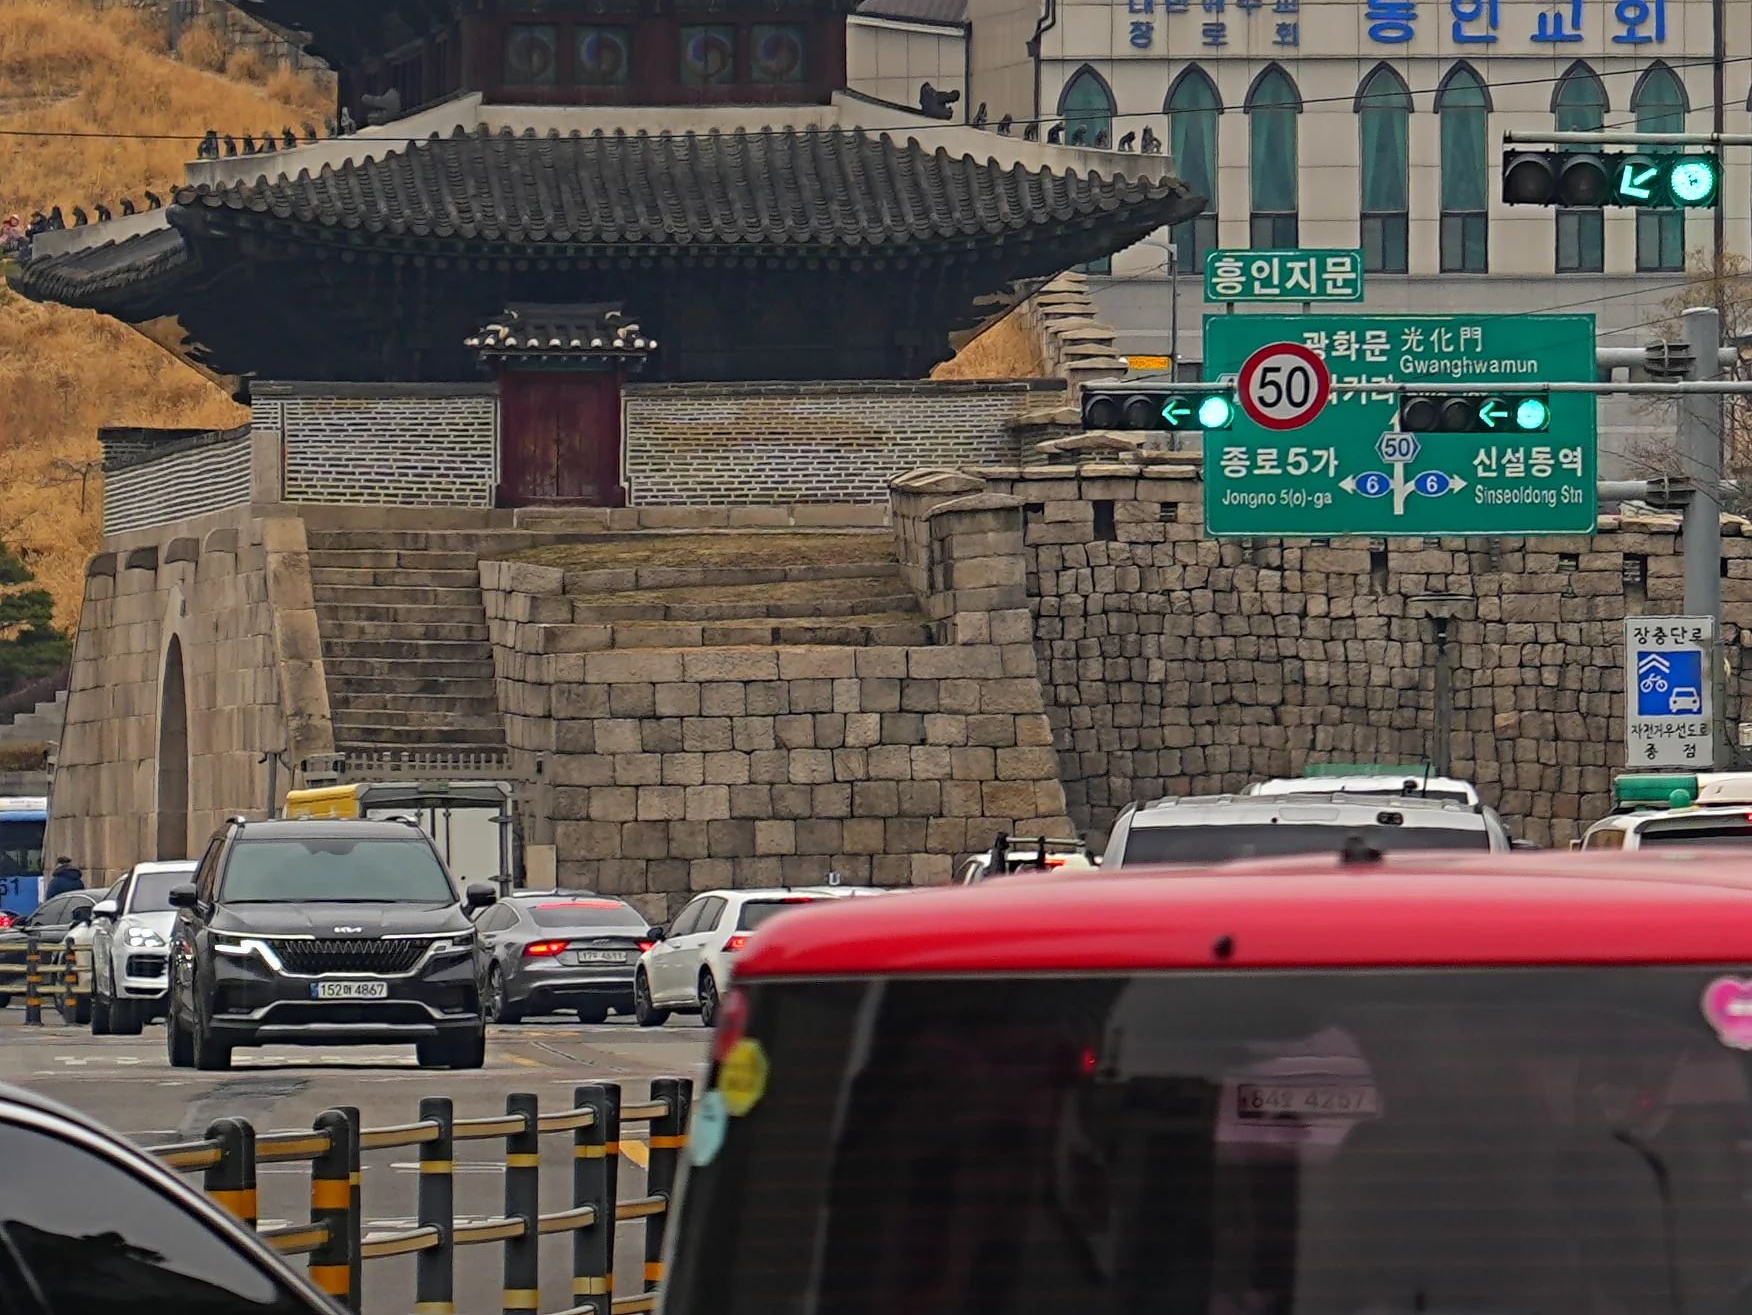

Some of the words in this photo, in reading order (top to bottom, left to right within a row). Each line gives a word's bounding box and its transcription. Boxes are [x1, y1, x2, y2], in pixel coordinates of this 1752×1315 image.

[1211, 256, 1357, 296] 흥인지문
[1302, 328, 1391, 362] 광화문
[1400, 326, 1483, 353] 光化門
[1400, 356, 1538, 377] Gwanghwamun
[1257, 365, 1311, 409] 50
[1384, 436, 1411, 458] 50
[1220, 447, 1339, 478] 종로5가
[1472, 446, 1583, 478] 신설동역
[1366, 475, 1380, 493] 6
[1426, 475, 1439, 493] 6
[1221, 488, 1276, 507] Jongno
[1280, 488, 1333, 507] 5(o)-ga
[1474, 484, 1557, 507] Sinseoldong
[1561, 485, 1583, 504] Stn
[1633, 626, 1710, 646] 장충단로
[1630, 722, 1710, 740] 자전거우선도로
[354, 983, 385, 997] 4867
